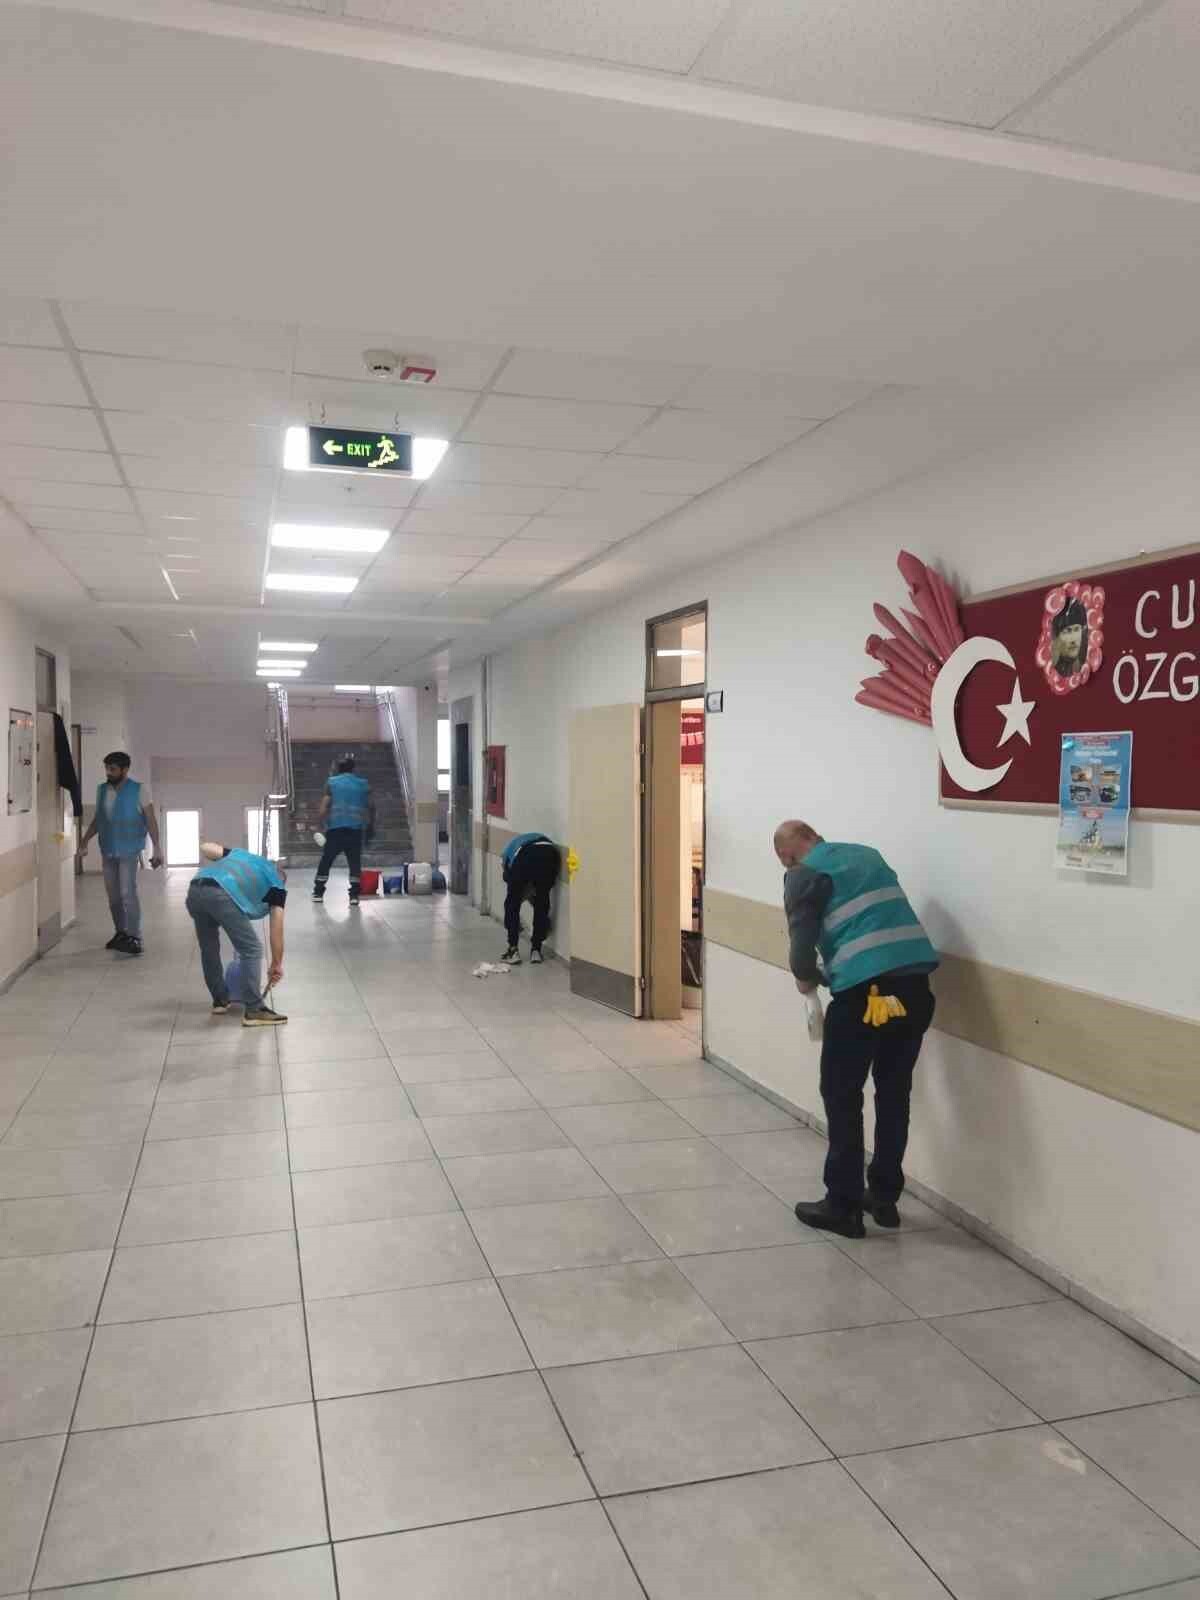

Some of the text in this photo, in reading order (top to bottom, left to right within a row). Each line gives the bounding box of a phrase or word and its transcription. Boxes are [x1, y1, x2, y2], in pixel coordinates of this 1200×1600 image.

[347, 443, 371, 456] EXIT
[1135, 579, 1195, 638] CU
[1112, 649, 1199, 704] ÖZG
